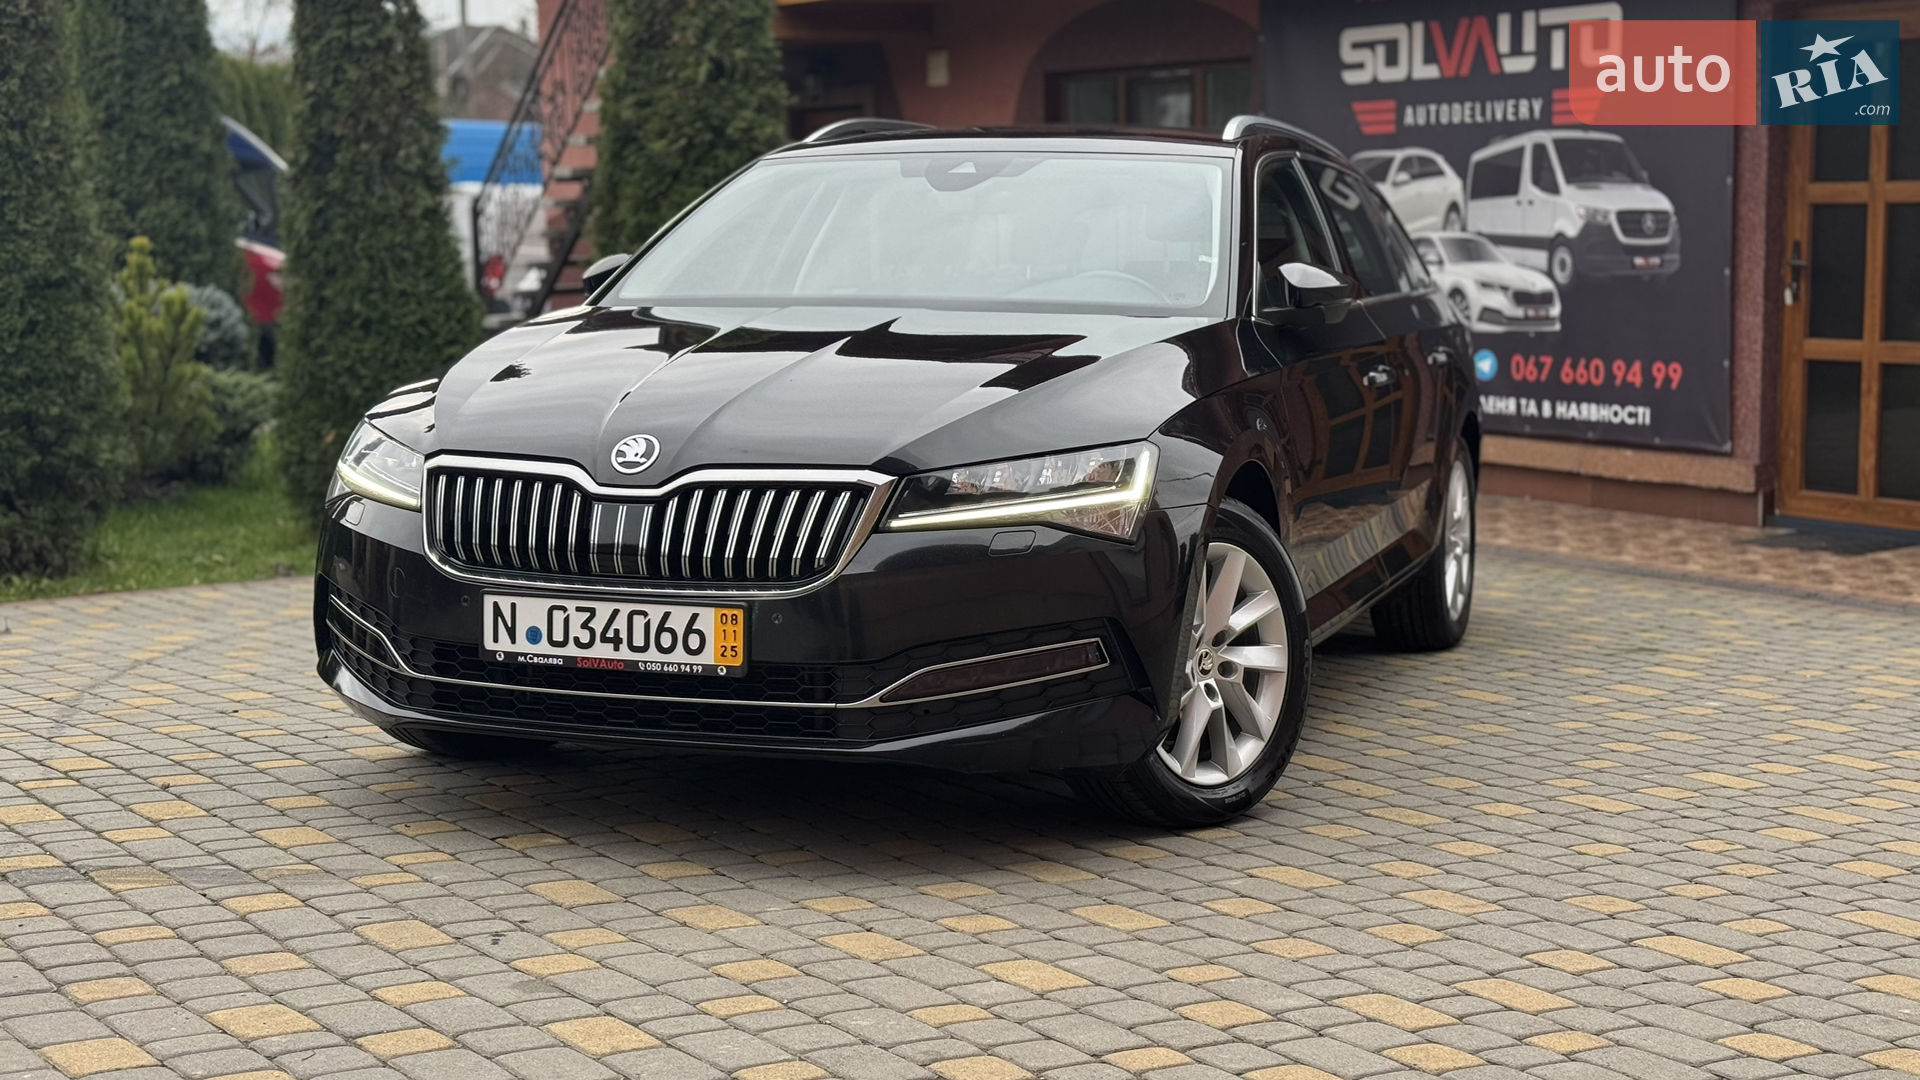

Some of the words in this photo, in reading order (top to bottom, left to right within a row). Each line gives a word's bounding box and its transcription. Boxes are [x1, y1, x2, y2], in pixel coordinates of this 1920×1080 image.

[1339, 1, 1624, 86] SOLVAUTO
[1403, 98, 1543, 127] AUTODELIVERY
[1510, 353, 1554, 383] 067
[1560, 356, 1606, 388] 660
[1611, 358, 1644, 389] 94
[1651, 360, 1683, 391] 99
[1519, 397, 1539, 418] ТА
[1541, 398, 1552, 419] В
[1555, 400, 1651, 426] НАЯВНОСТІ
[492, 600, 517, 645] N
[546, 604, 707, 657] 034066
[719, 612, 739, 626] 08
[721, 629, 738, 641] 11
[719, 645, 738, 658] 25
[576, 657, 625, 670] SolVAuto
[646, 662, 662, 671] 050
[663, 663, 679, 672] 660
[680, 664, 691, 673] 94
[692, 665, 703, 673] 99
